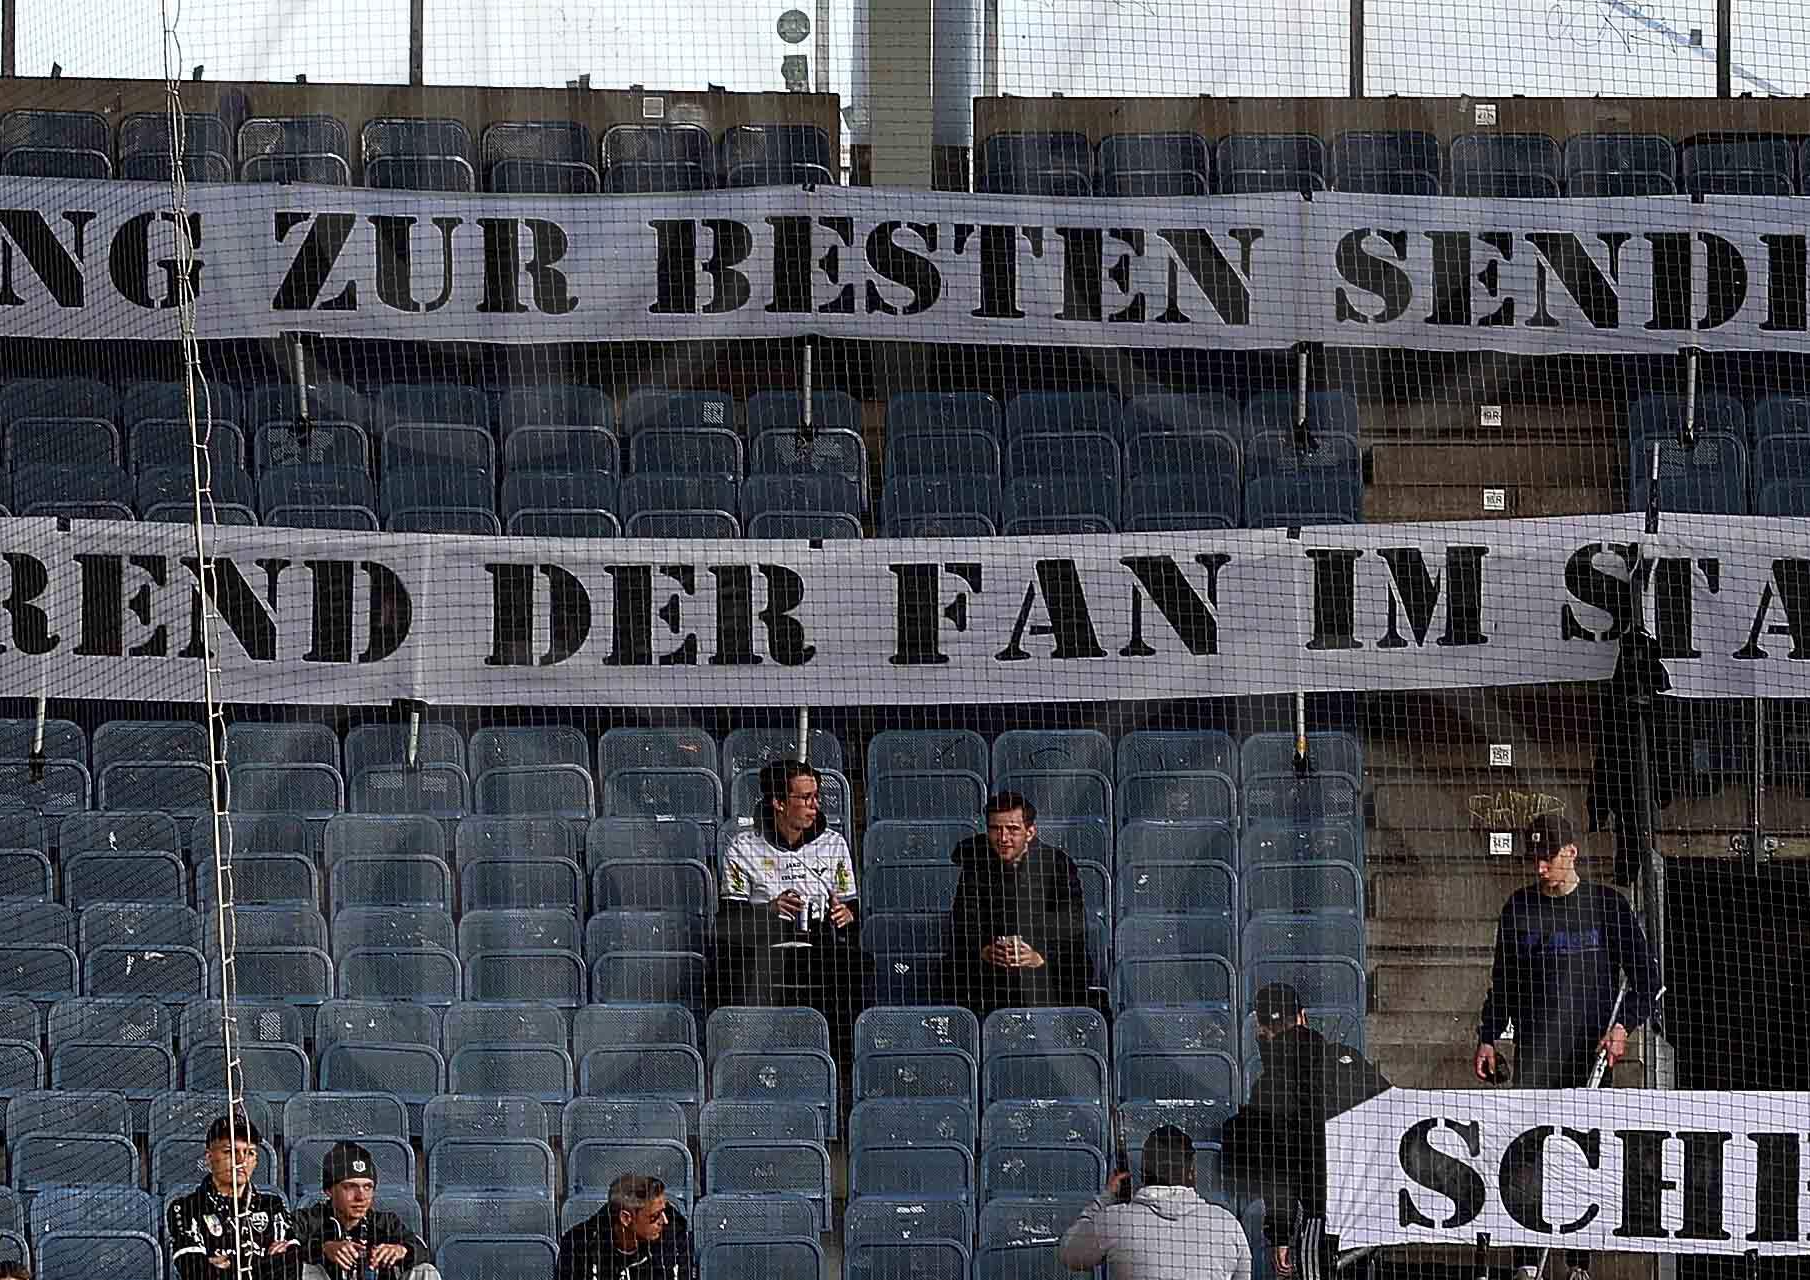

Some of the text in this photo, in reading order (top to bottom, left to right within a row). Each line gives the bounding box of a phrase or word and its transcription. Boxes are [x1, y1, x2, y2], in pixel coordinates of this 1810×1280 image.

[272, 210, 579, 316] ZUR
[648, 214, 1264, 327] BESTEN
[484, 562, 816, 667] DER
[888, 553, 1232, 665] FAN
[1305, 545, 1490, 651] IM
